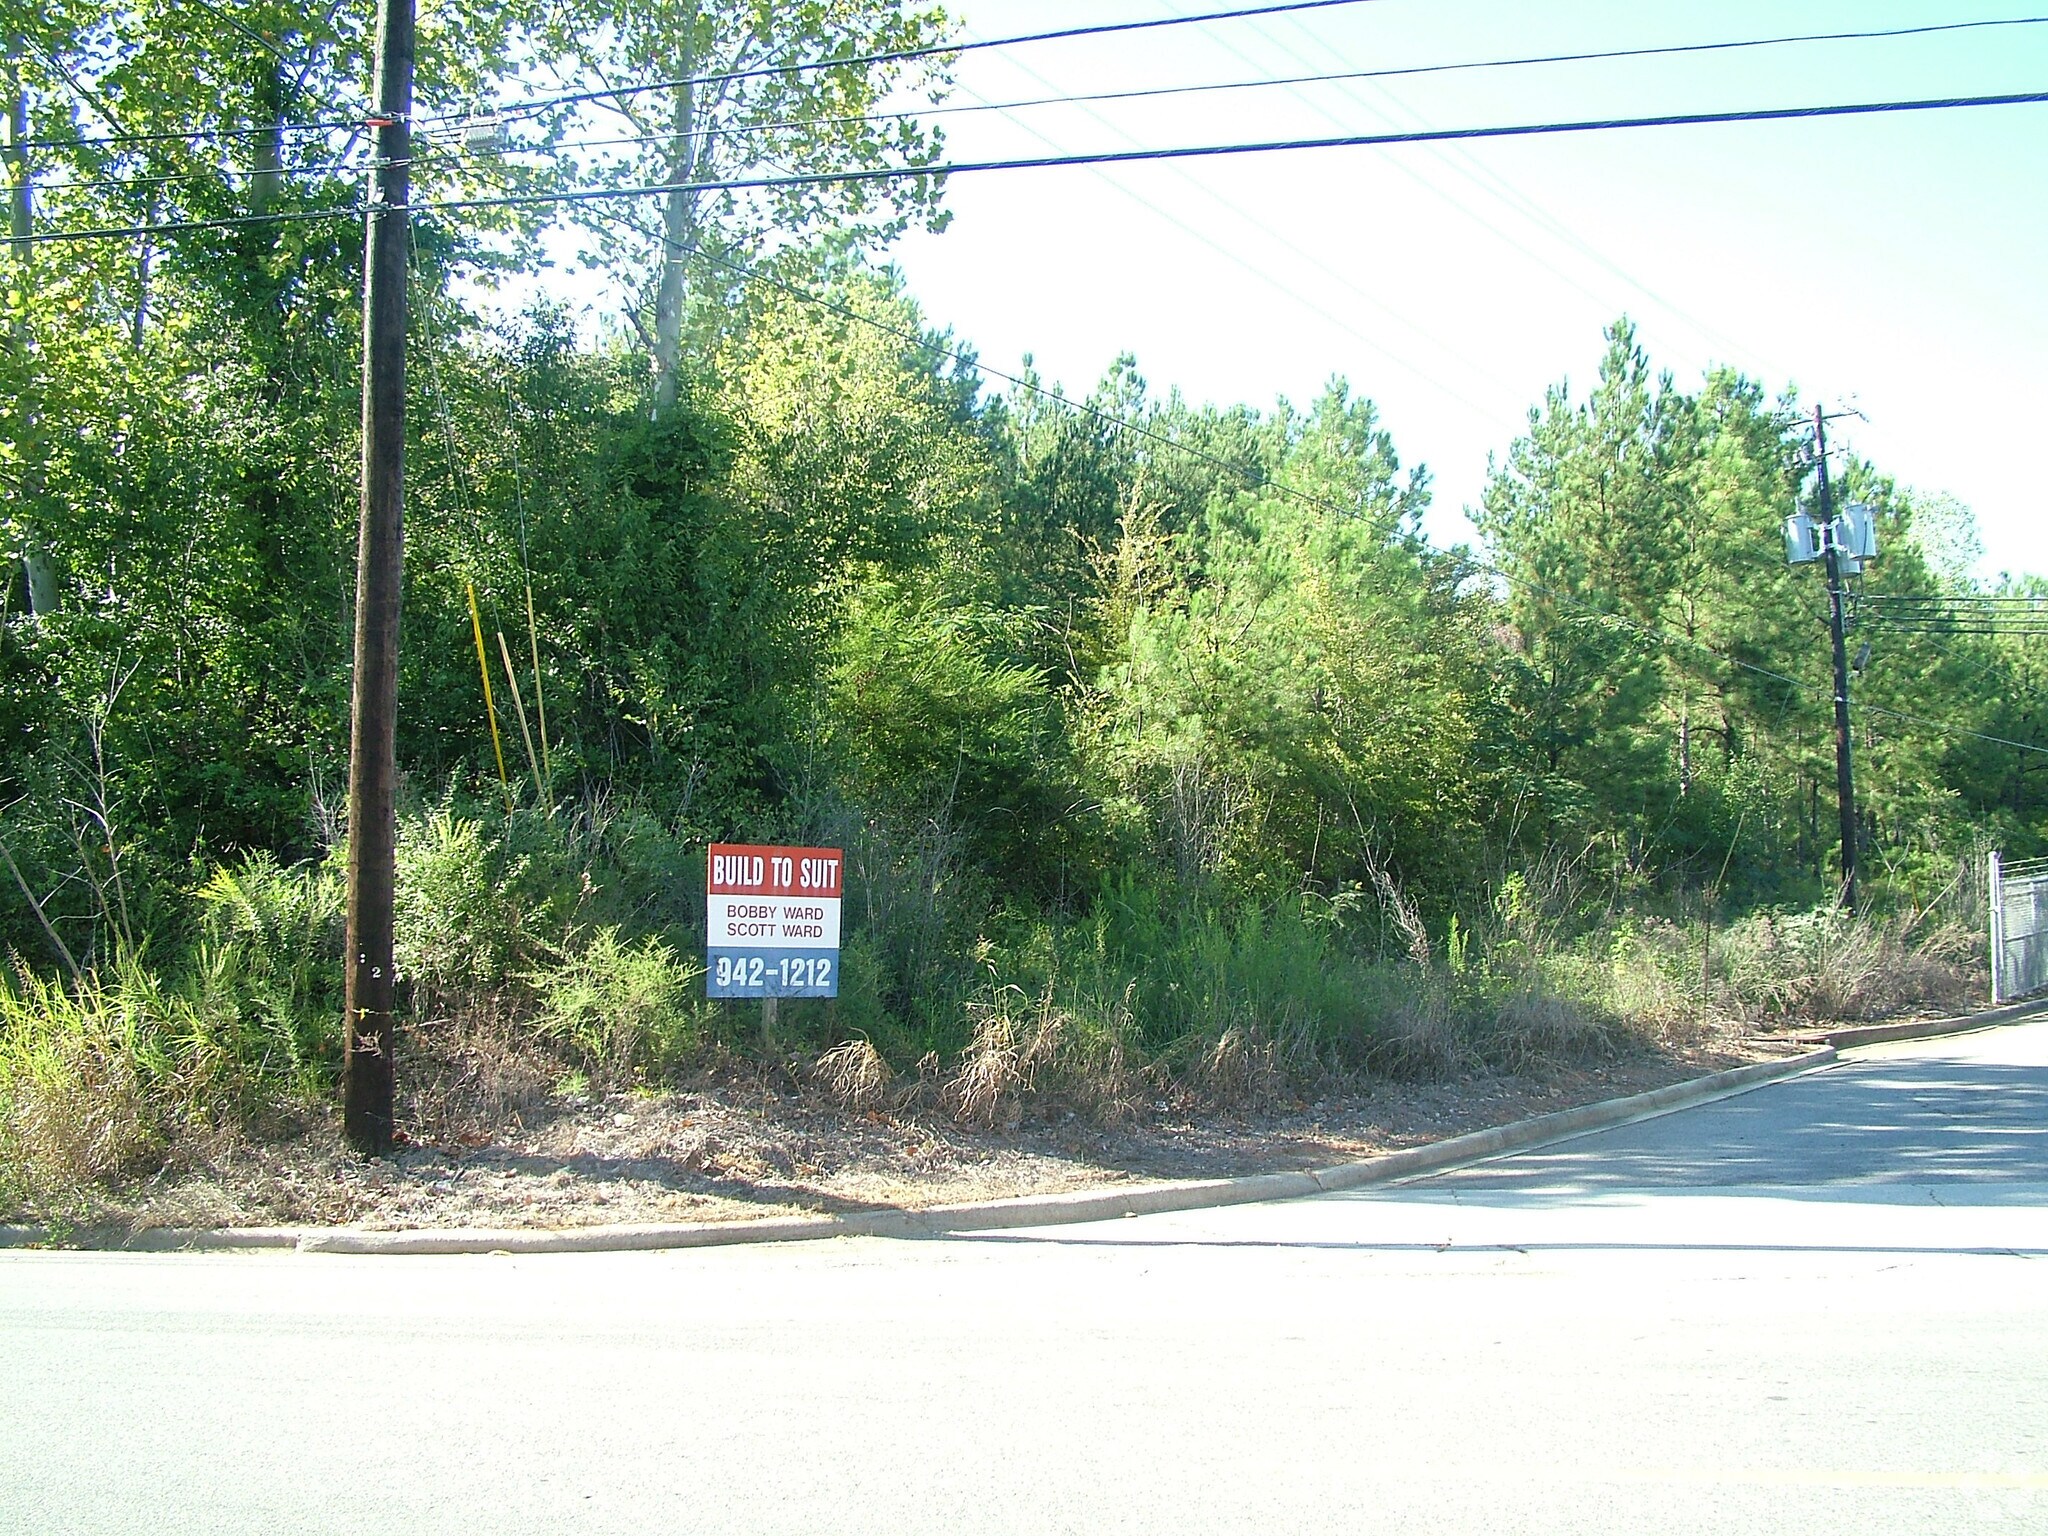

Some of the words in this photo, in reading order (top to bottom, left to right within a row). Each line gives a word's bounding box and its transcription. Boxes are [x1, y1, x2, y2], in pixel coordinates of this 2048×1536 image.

[713, 855, 764, 886] BUILD
[771, 857, 793, 887] TO
[800, 858, 839, 888] SUIT
[727, 905, 777, 919] BOBBY
[783, 907, 824, 921] WARD
[727, 923, 777, 937] SCOTT
[782, 924, 823, 938] WARD
[371, 966, 381, 979] 2
[716, 957, 832, 987] 942-1212
